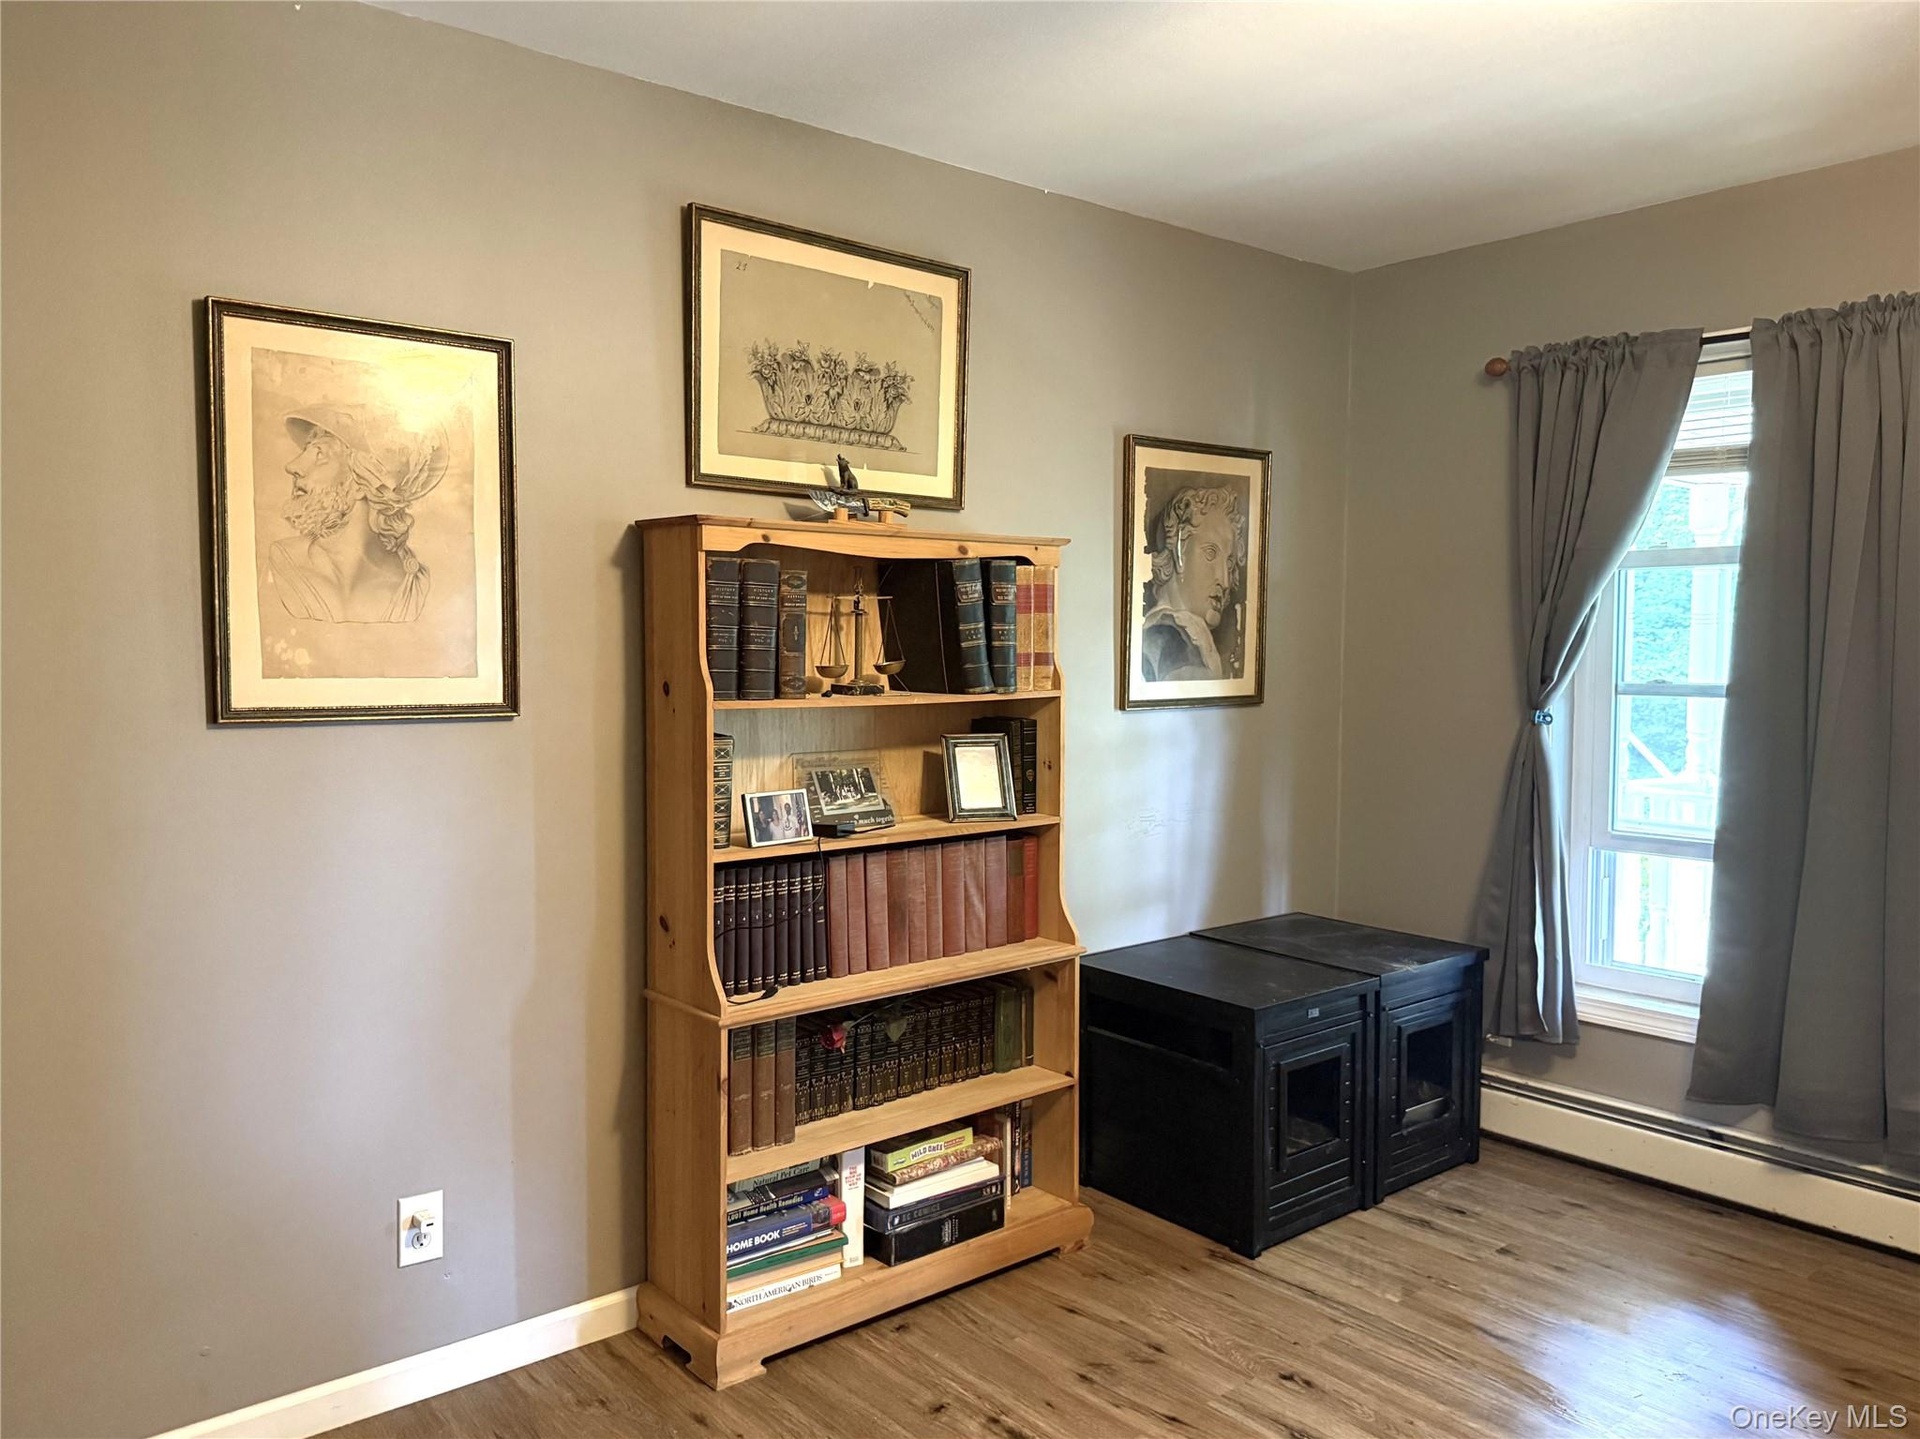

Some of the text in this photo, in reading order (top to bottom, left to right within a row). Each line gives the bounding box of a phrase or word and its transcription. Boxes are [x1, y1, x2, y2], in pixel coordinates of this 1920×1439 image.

[911, 1146, 927, 1160] WILD
[753, 1165, 810, 1187] Natural Pet Care
[743, 1207, 759, 1217] Home
[759, 1202, 778, 1212] Health
[778, 1196, 804, 1208] Remedies
[726, 1230, 780, 1254] HOME BOOK
[734, 1274, 823, 1308] NORTH AMERICAN BIRDS
